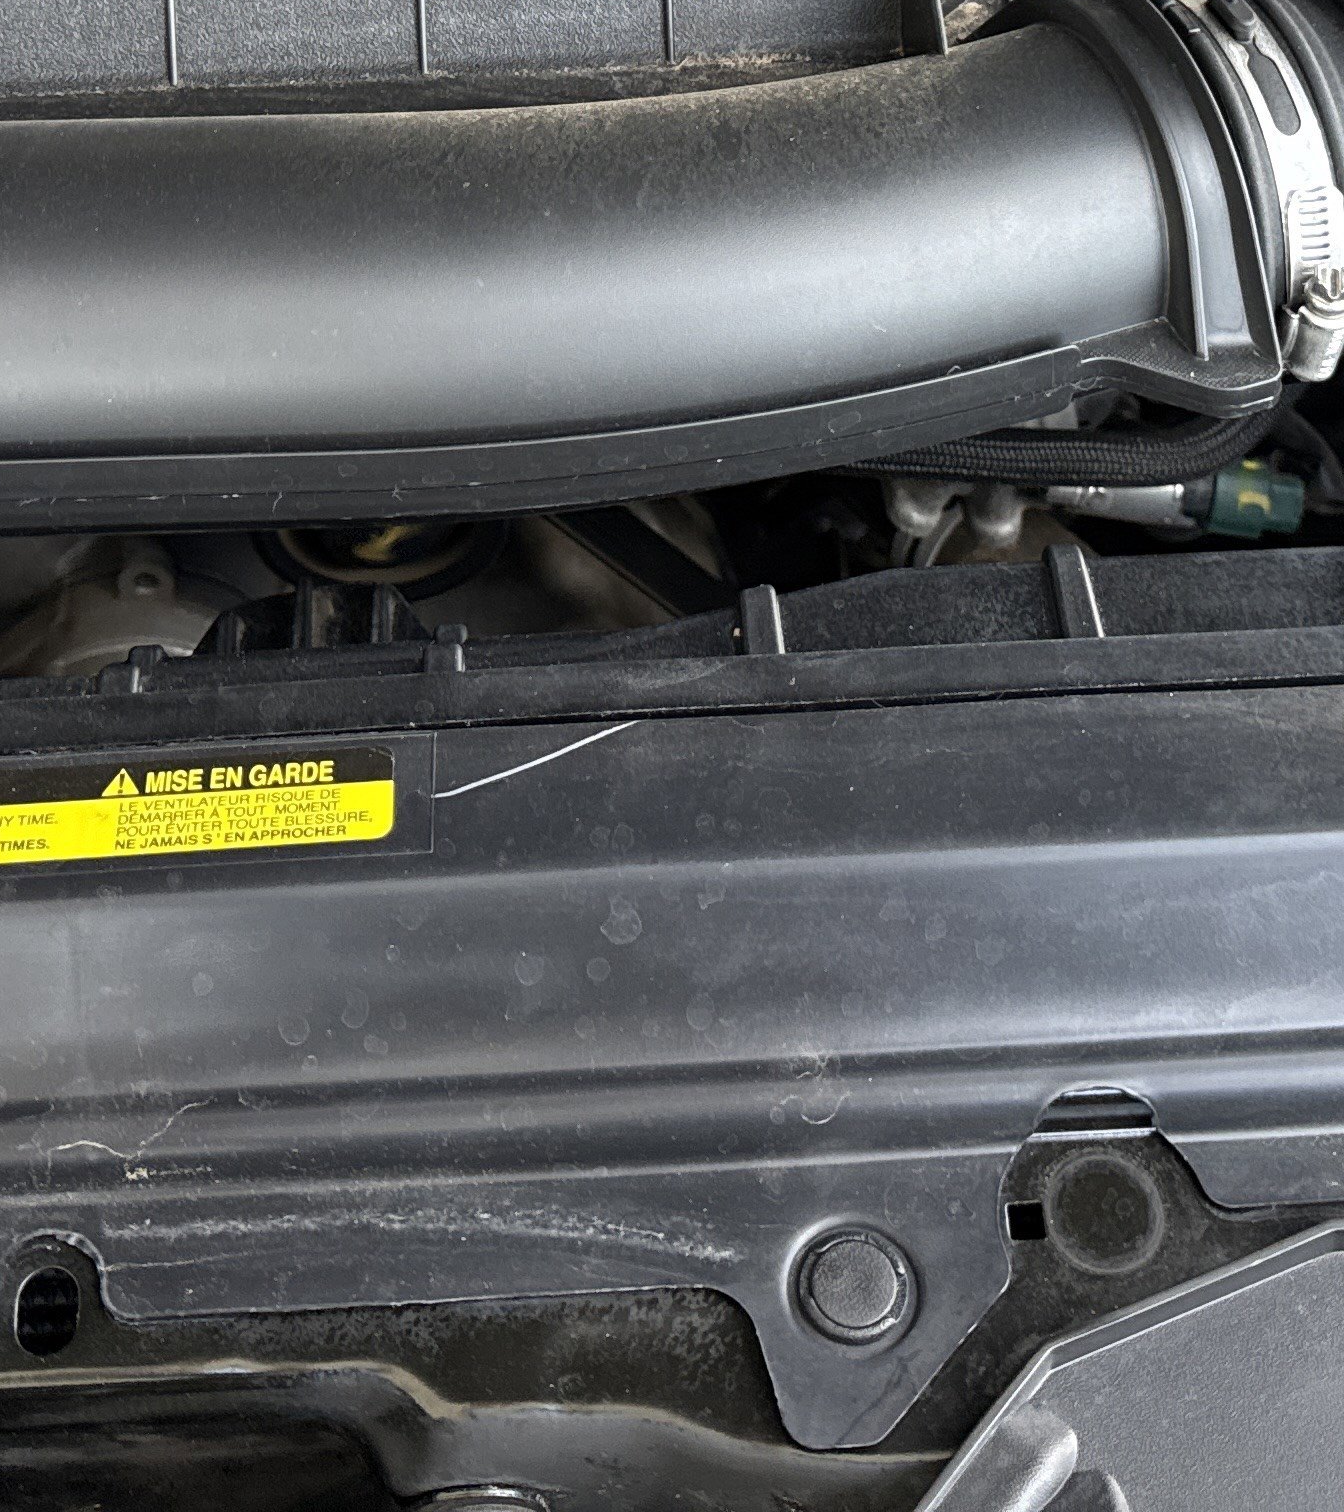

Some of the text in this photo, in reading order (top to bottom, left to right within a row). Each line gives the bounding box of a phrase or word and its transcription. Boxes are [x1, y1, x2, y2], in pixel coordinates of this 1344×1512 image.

[144, 760, 335, 794] MISE EN GARDE
[119, 788, 342, 813] LE VENTILATEUR RISQUE DE
[18, 813, 58, 826] TIME.
[116, 810, 373, 837] POUR ÉVITER TOUTE BLESSURE,
[118, 808, 205, 825] DÉMARRER
[225, 805, 267, 818] TOUT
[114, 838, 137, 850] NE
[139, 834, 199, 849] JAMAIS
[248, 825, 347, 841] APPROCHER
